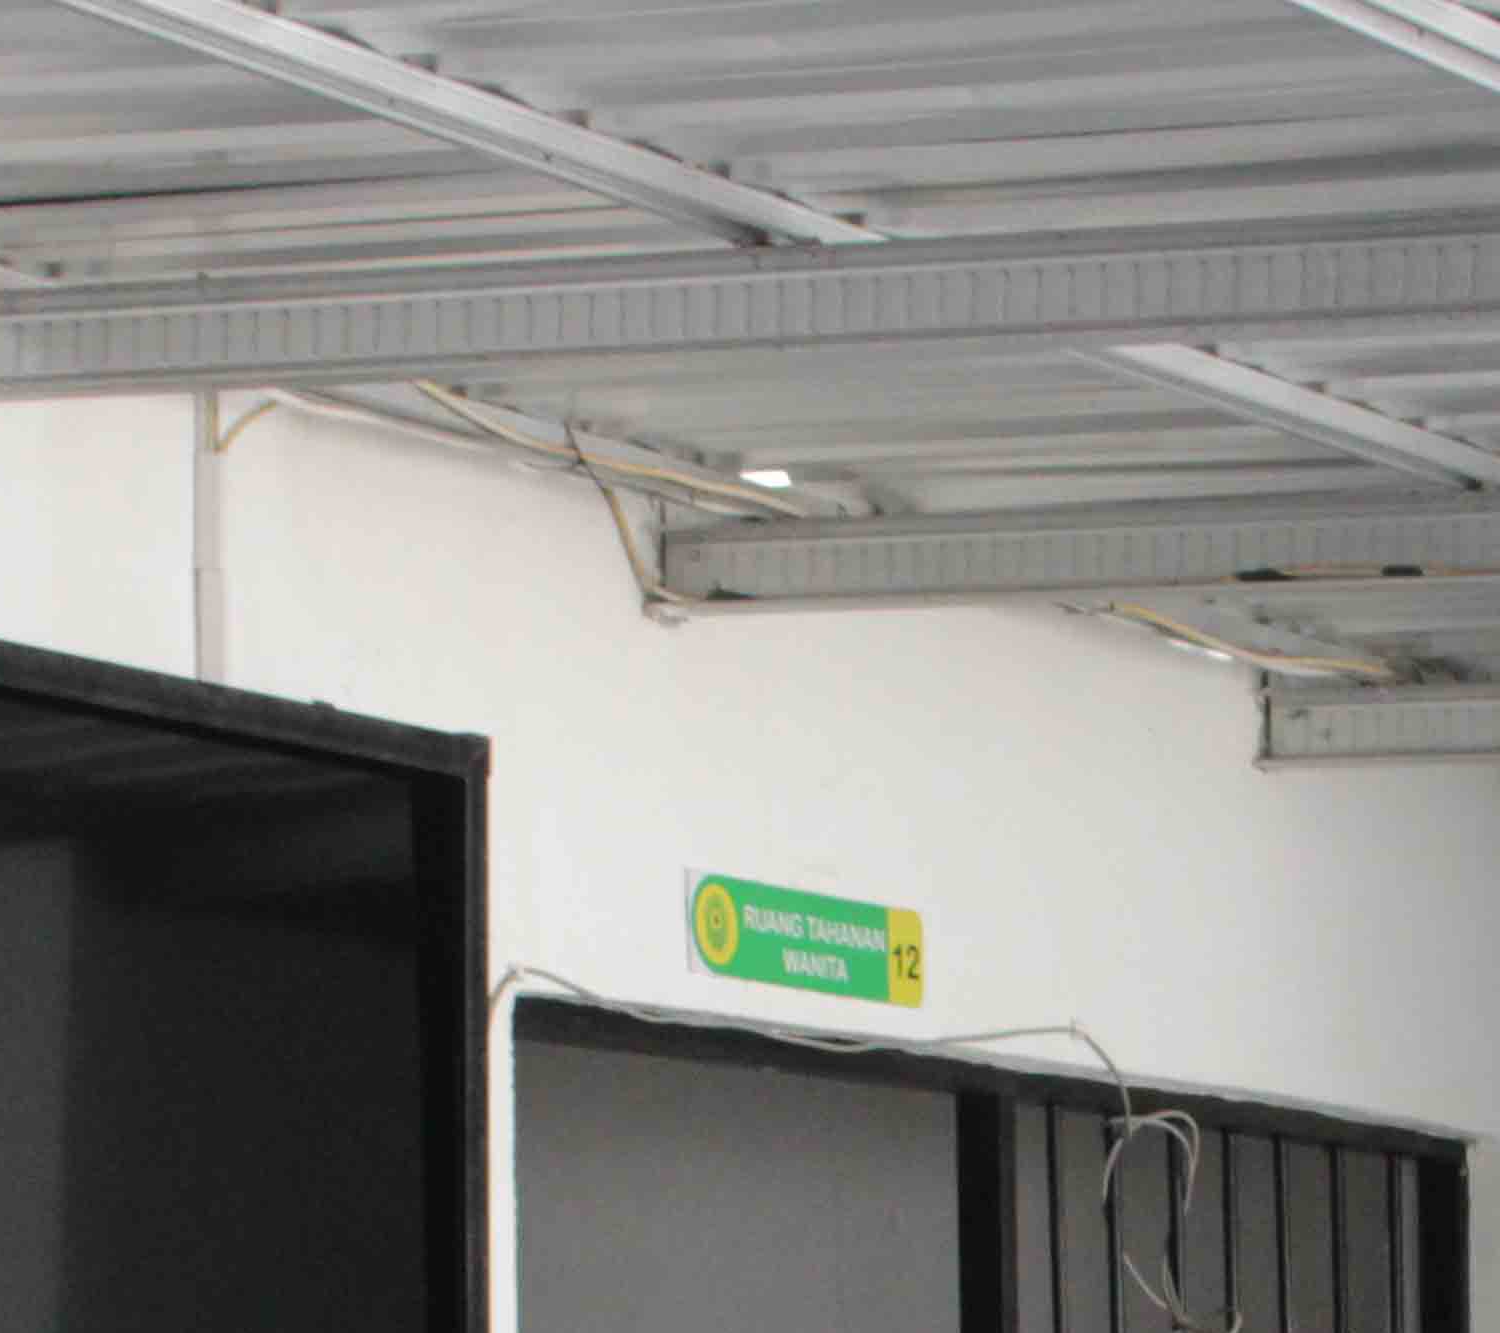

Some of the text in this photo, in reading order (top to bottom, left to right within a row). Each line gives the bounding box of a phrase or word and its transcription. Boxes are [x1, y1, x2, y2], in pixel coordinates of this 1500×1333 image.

[742, 904, 886, 952] RUANG TAHANAN
[782, 947, 850, 984] WANITA
[892, 944, 920, 981] 12
